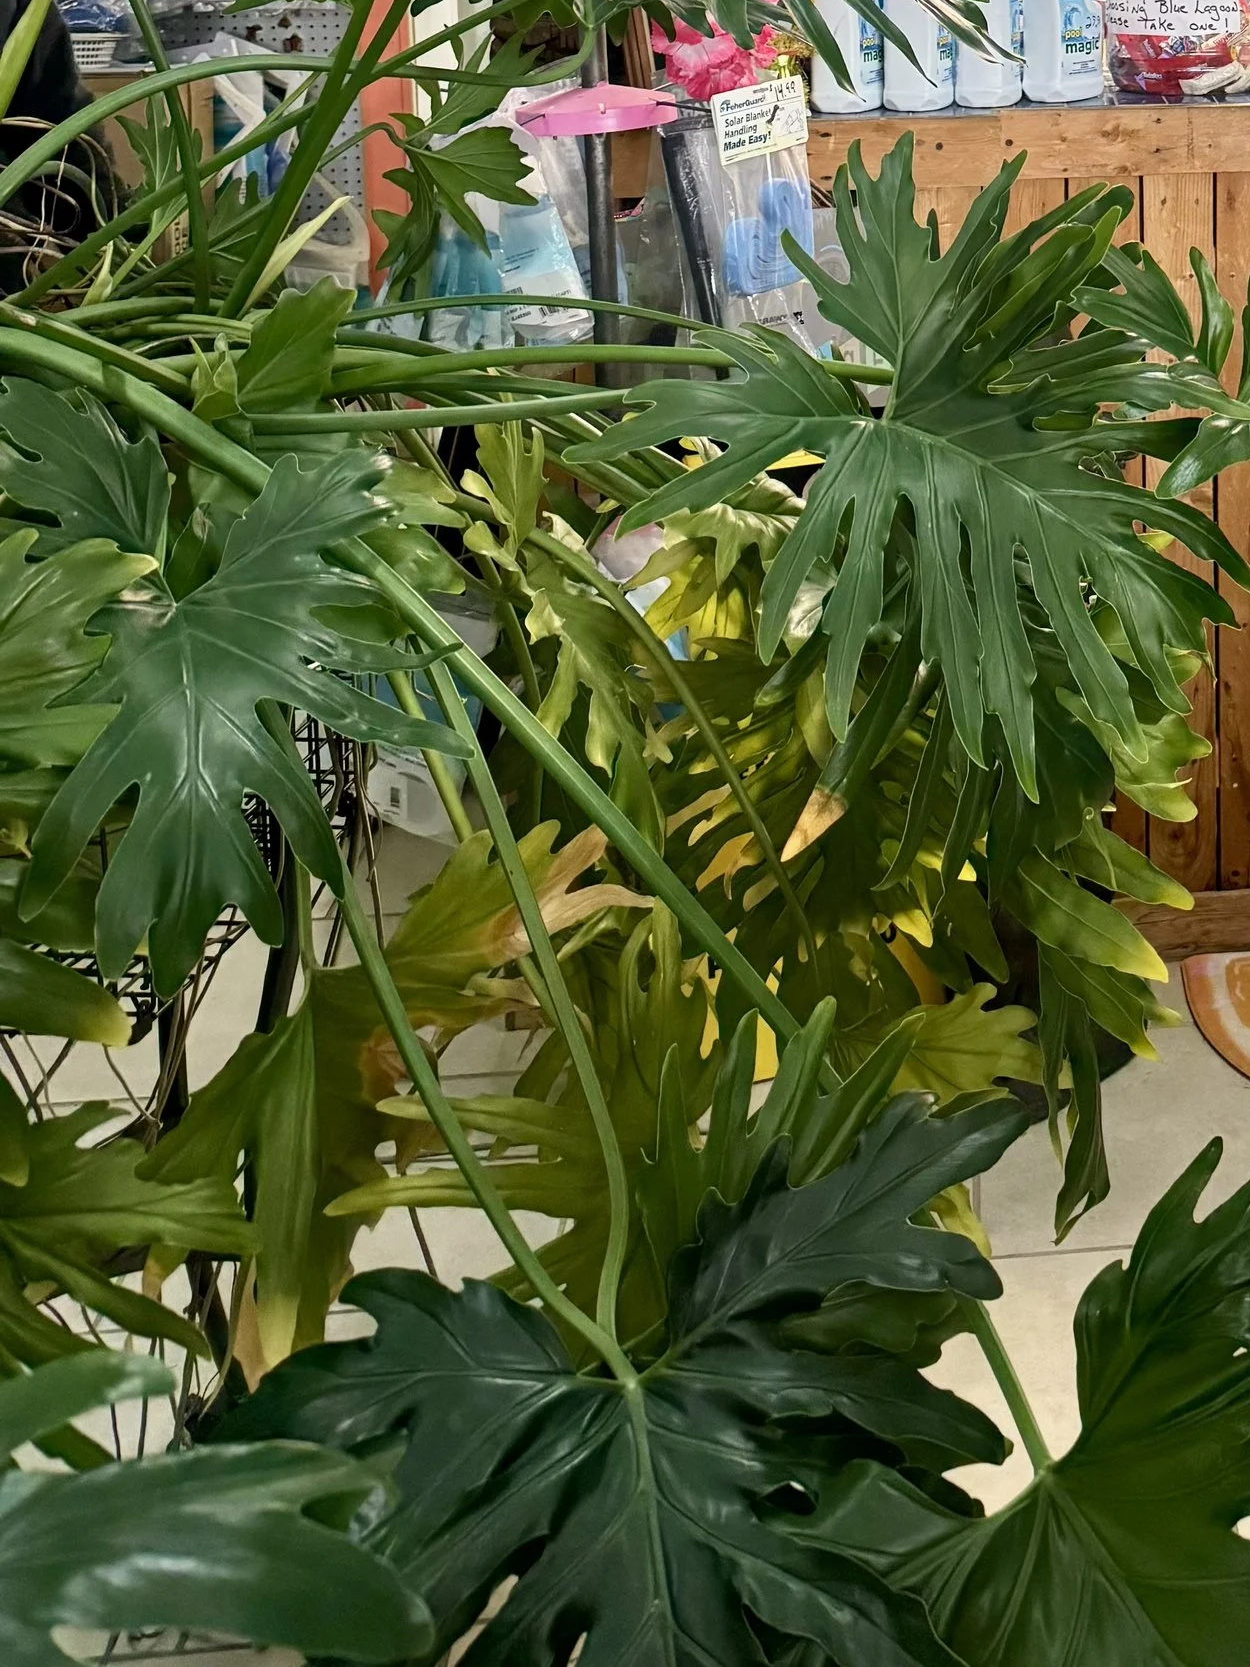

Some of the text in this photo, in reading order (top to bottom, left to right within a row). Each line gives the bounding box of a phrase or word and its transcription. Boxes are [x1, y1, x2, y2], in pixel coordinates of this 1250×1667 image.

[1107, 0, 1147, 20] oosing
[1155, 0, 1188, 14] Blue
[1065, 36, 1100, 55] magic
[725, 108, 771, 128] Solar Blanket
[723, 130, 771, 151] Made Easy!
[724, 124, 758, 139] Handling
